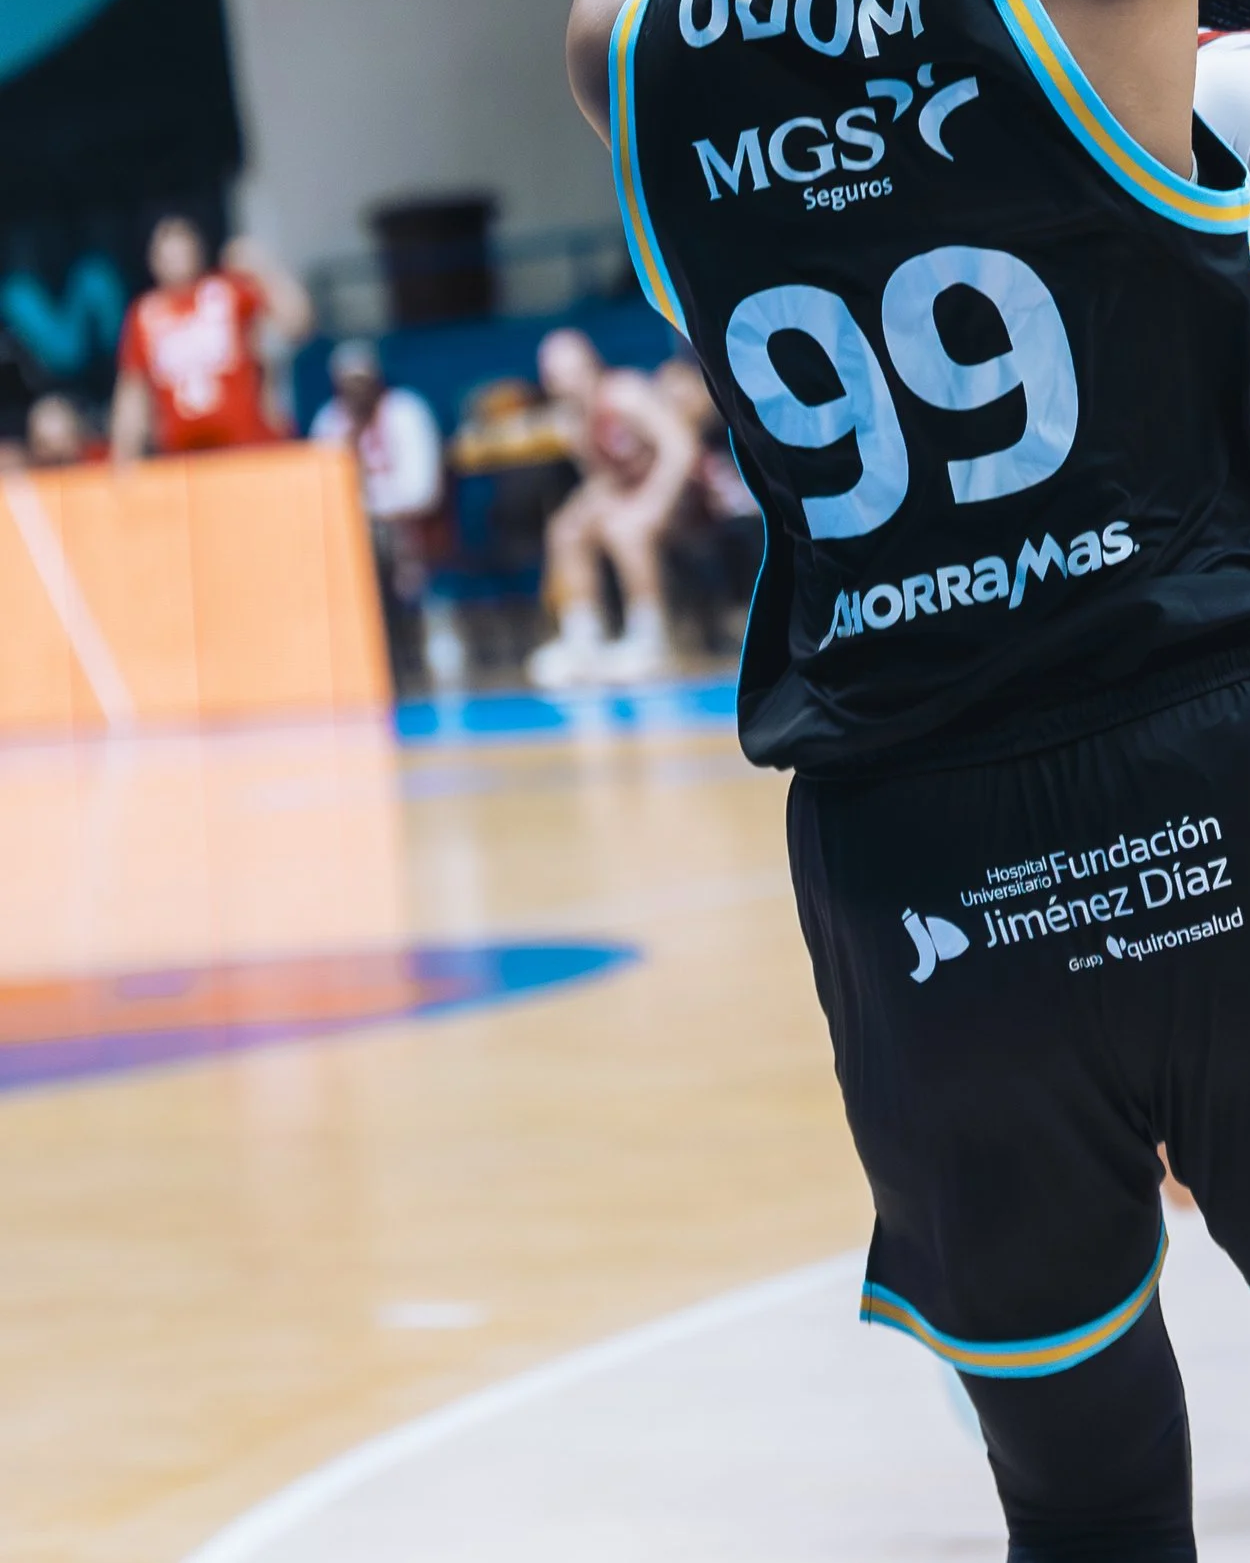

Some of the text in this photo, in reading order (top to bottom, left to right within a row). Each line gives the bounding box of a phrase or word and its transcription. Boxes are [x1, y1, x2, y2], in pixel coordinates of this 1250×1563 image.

[691, 106, 886, 202] MGS
[803, 175, 893, 212] Seguros
[726, 245, 1080, 540] 99
[986, 856, 1048, 885] Hospital
[1049, 816, 1223, 884] Fundación
[960, 874, 1052, 908] Universitario
[983, 857, 1233, 949] Jiménez Díaz
